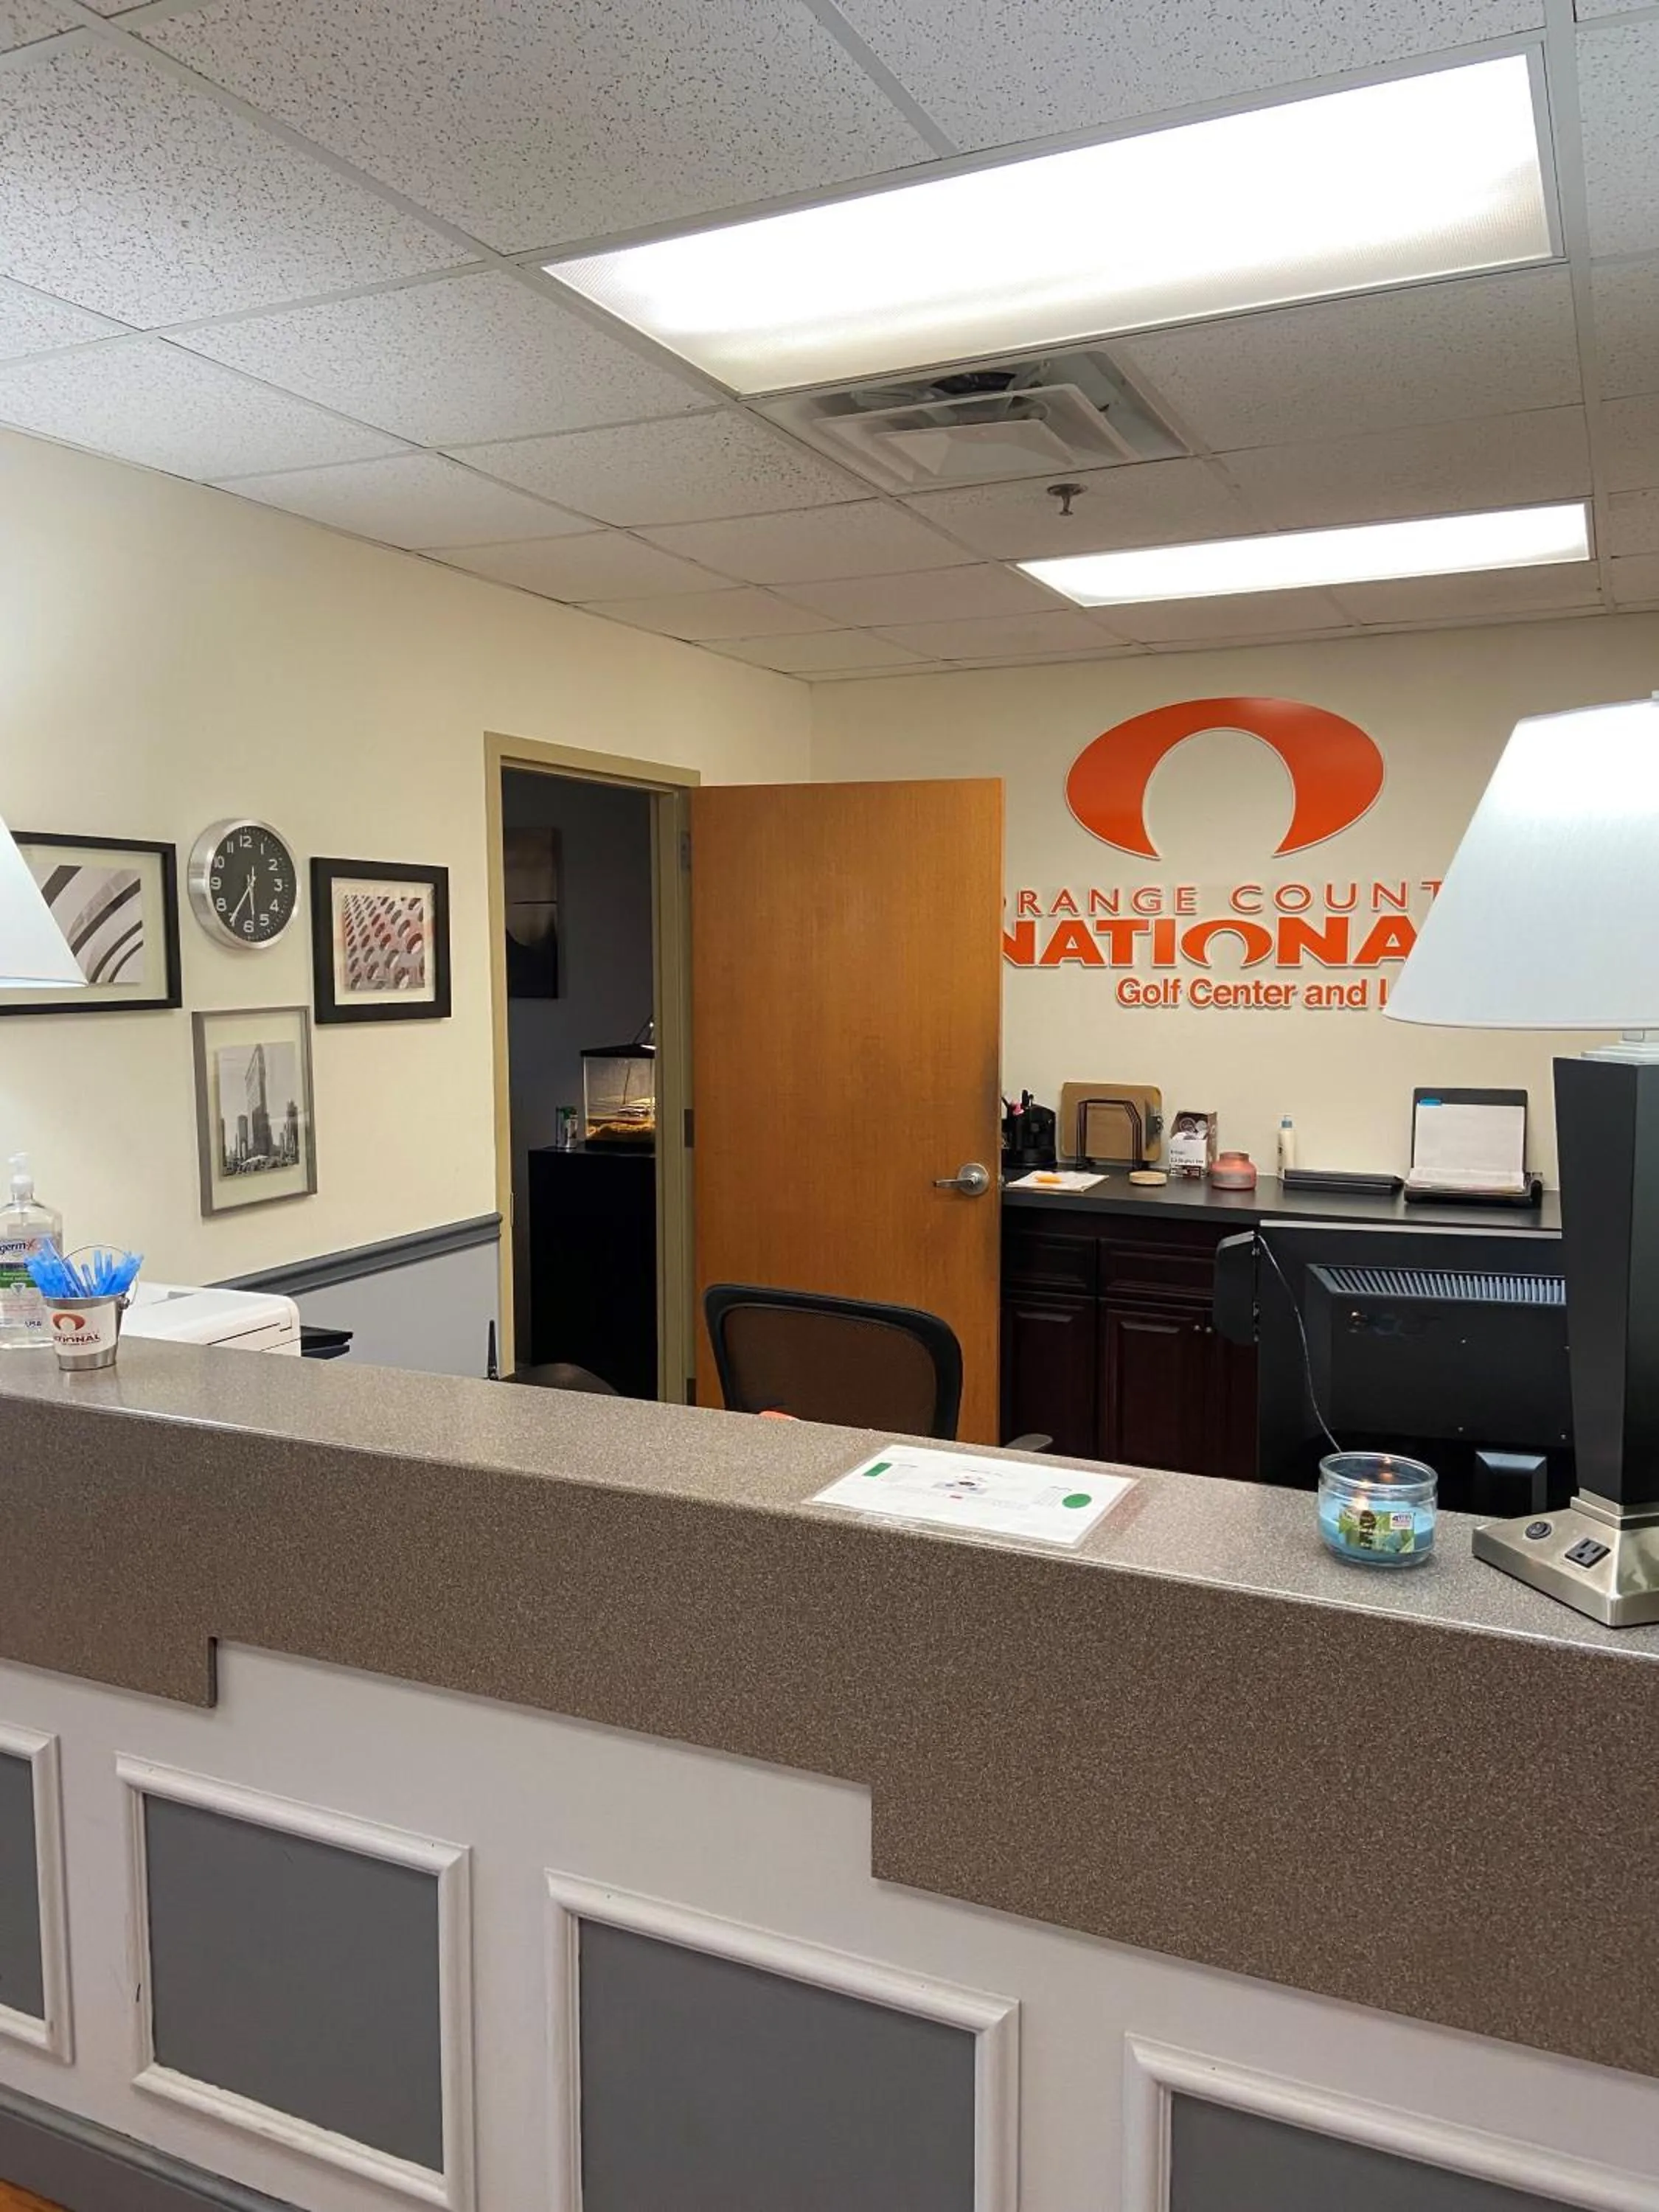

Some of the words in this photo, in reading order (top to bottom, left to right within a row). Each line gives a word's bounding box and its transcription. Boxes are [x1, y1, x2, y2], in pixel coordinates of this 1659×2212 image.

[227, 841, 234, 854] 11
[240, 835, 252, 848] 12
[214, 855, 225, 869] 10
[268, 859, 278, 871] 2
[211, 877, 221, 890] 9
[274, 878, 282, 891] 3
[1004, 886, 1197, 914] RANGE
[1230, 881, 1443, 912] COUNT
[217, 898, 226, 912] 8
[270, 899, 279, 912] 4
[243, 920, 254, 933] 6
[260, 914, 269, 926] 5
[1003, 915, 1417, 967] NATIONA
[1117, 977, 1180, 1006] Golf
[1189, 978, 1295, 1006] Center
[1304, 978, 1367, 1006] and
